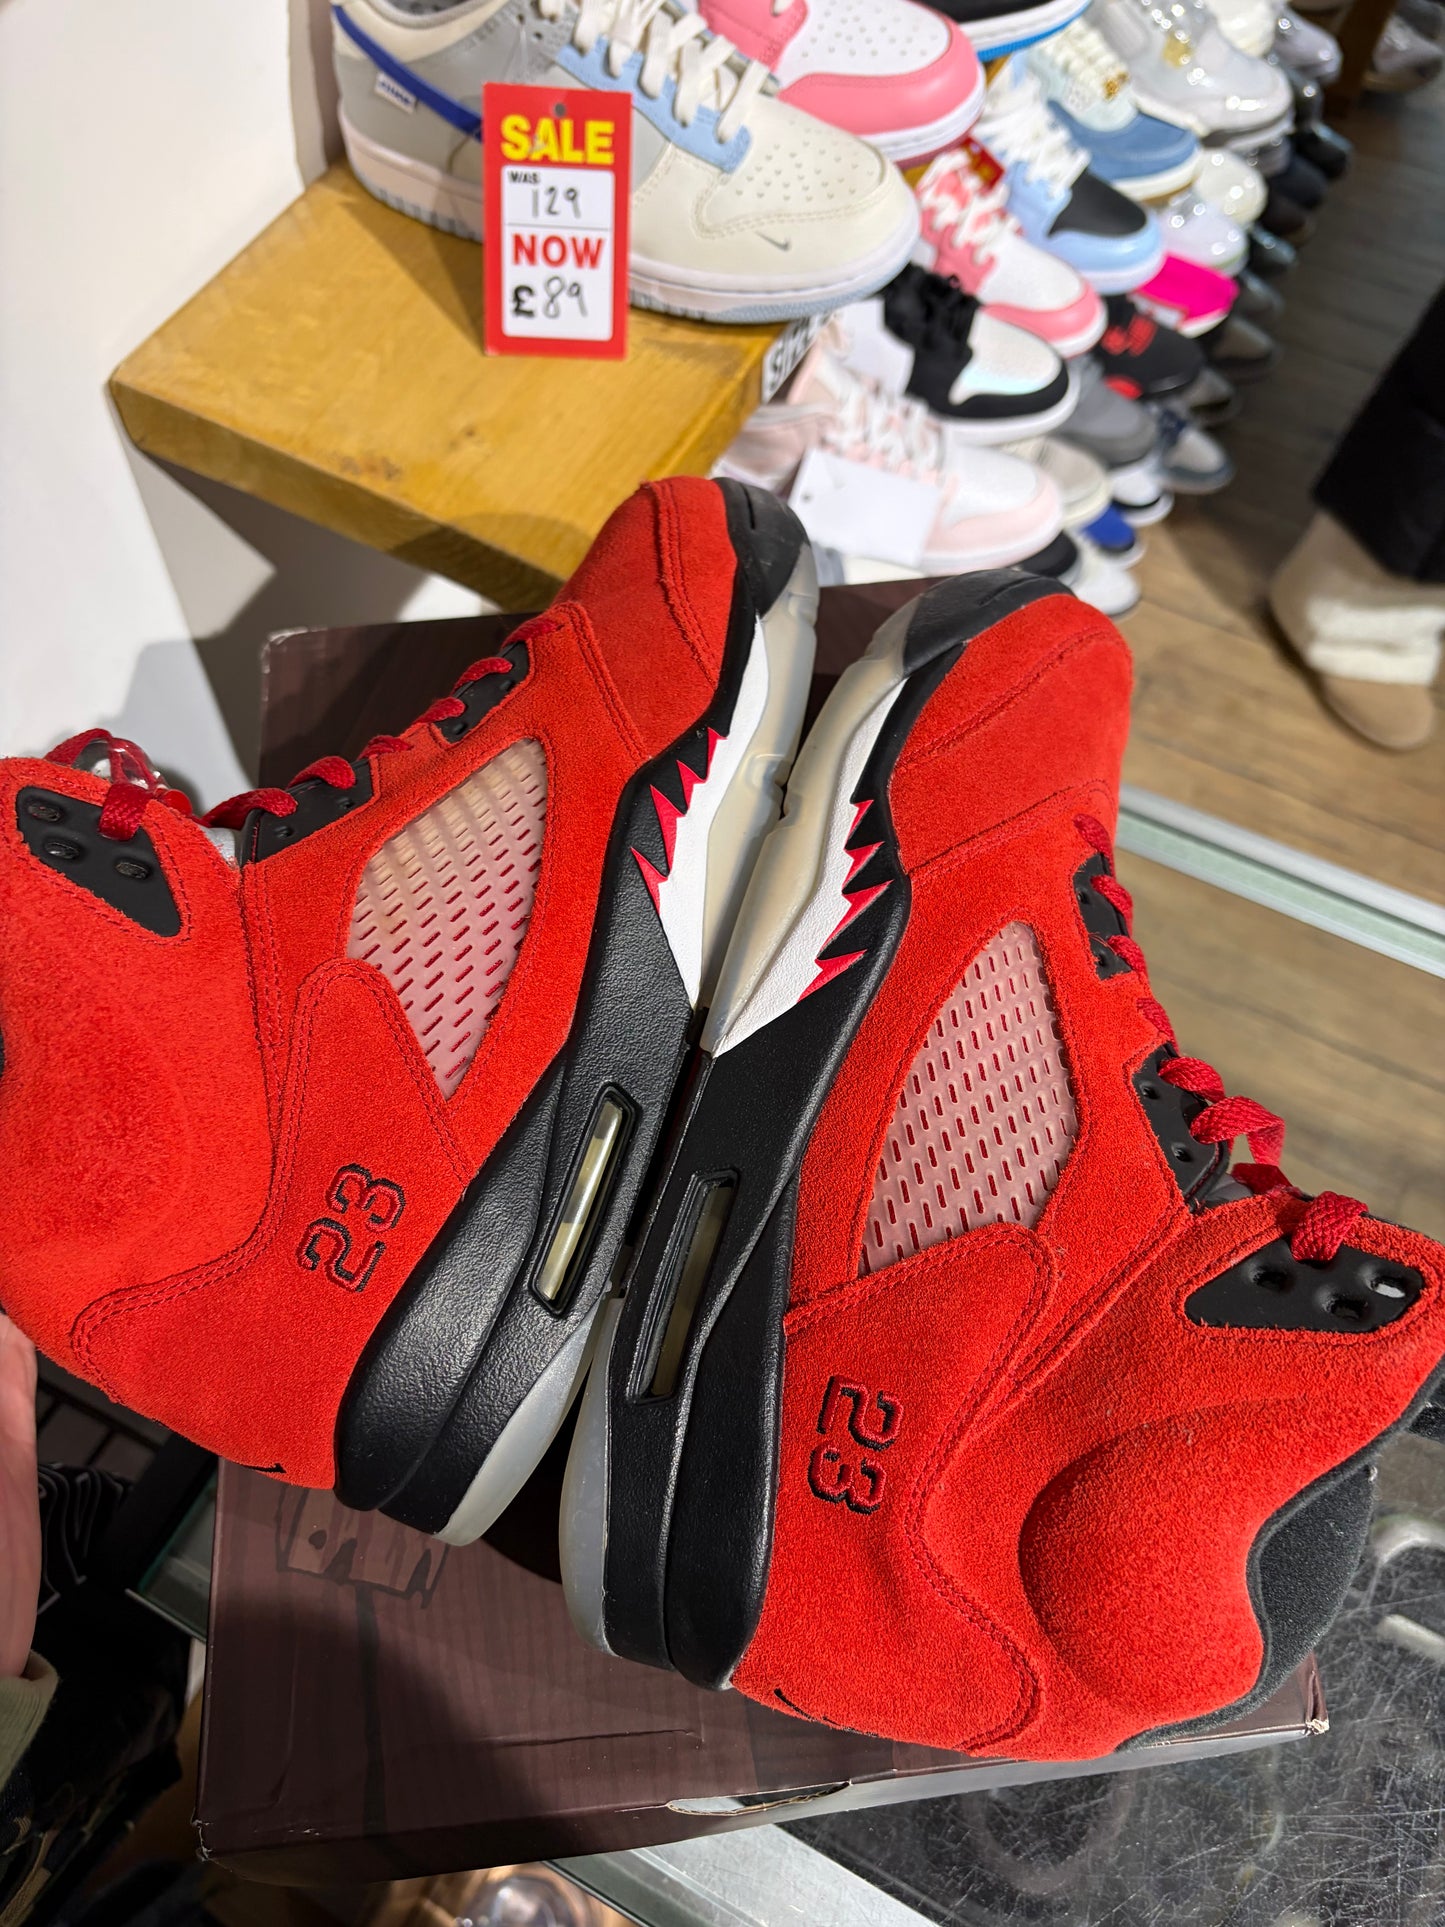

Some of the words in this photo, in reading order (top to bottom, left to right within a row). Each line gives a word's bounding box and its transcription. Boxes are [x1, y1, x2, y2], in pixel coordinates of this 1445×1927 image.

[501, 115, 615, 165] SALE
[507, 170, 540, 184] WAS
[532, 187, 581, 218] 129
[511, 234, 605, 269] NOW
[511, 276, 588, 319] £89
[297, 1163, 406, 1293] 23
[807, 1375, 904, 1516] 23
